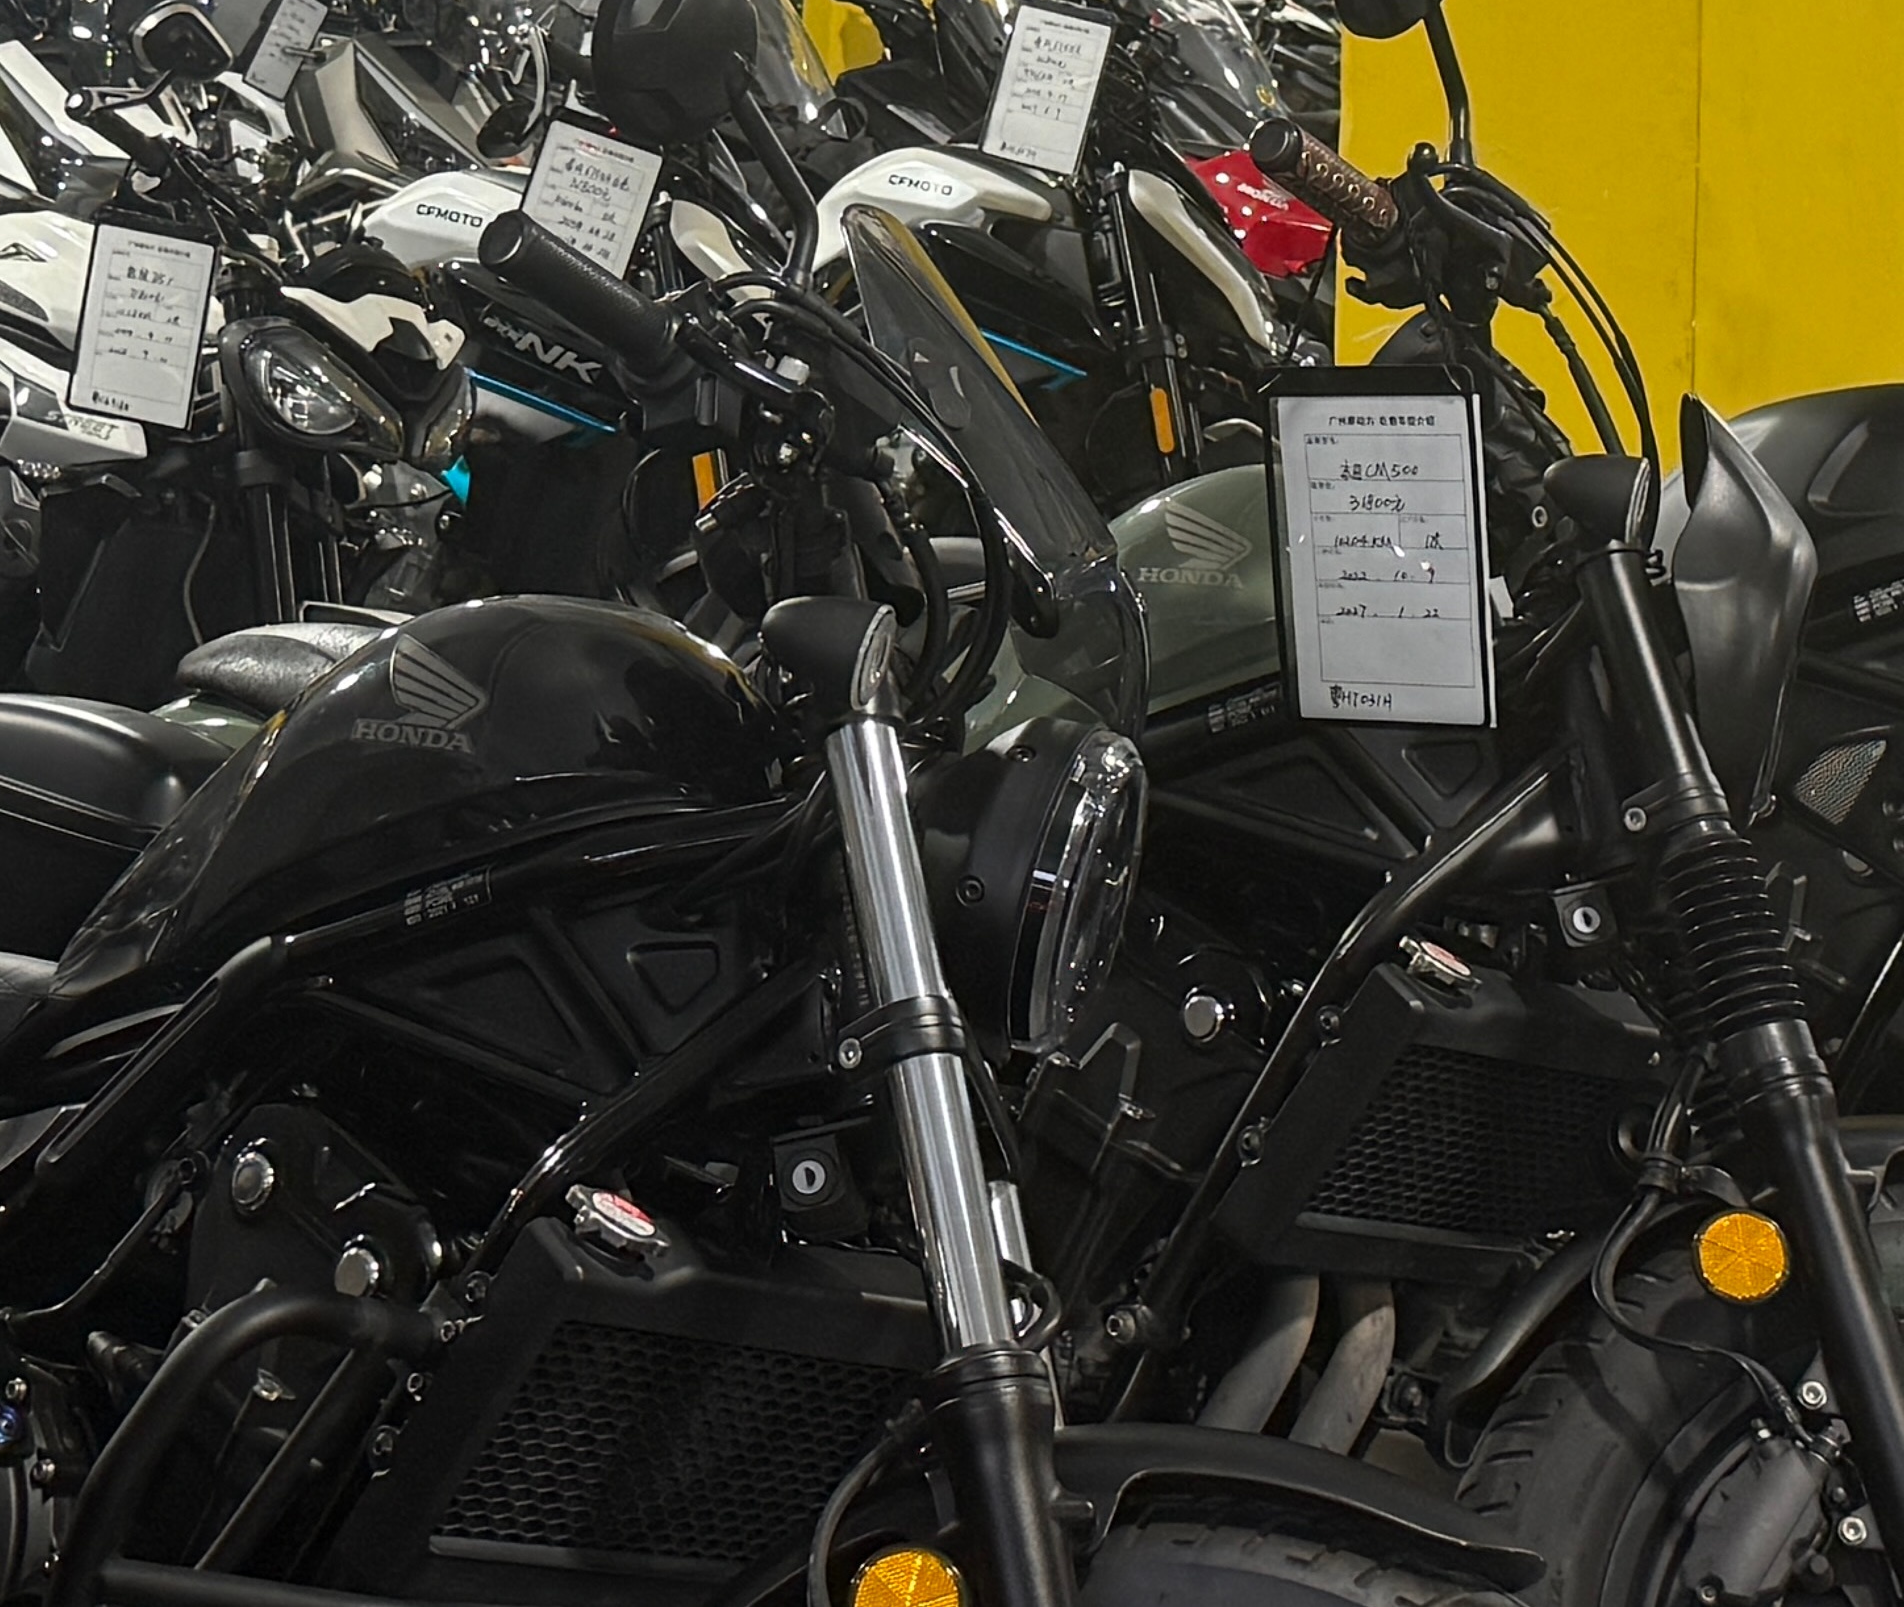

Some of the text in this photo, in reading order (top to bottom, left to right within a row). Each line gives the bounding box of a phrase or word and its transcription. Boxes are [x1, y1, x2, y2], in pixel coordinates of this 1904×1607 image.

[888, 174, 953, 195] CFMOTO
[416, 204, 483, 228] CFMOTO
[1138, 567, 1244, 589] HONDA
[352, 718, 474, 754] HONDA
